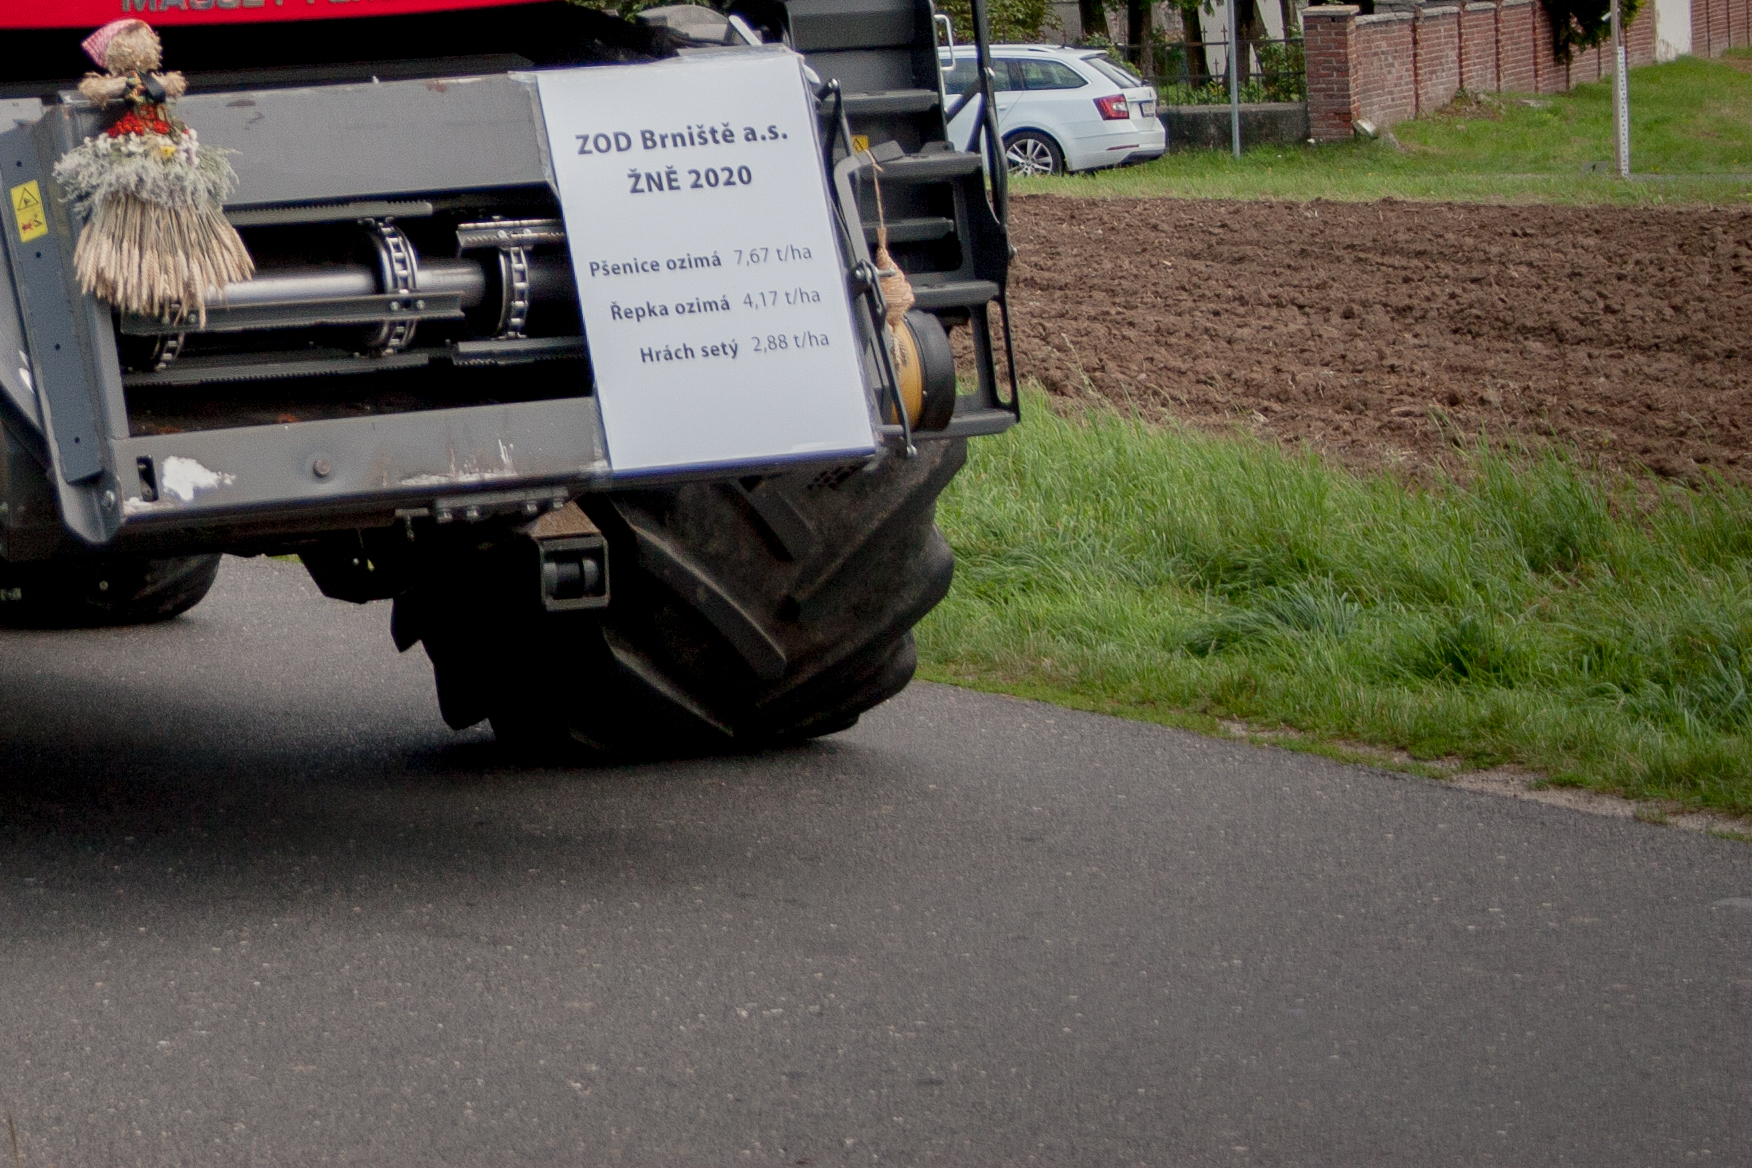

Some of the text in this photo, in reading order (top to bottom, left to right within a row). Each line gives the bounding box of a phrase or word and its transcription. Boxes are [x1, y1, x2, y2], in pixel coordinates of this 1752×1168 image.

[575, 122, 788, 155] ZOD Brniště a.s.
[627, 165, 752, 194] ŽNĚ 2020
[589, 244, 812, 277] Pšenice ozimá 7,67 t/ha
[610, 287, 821, 323] Řepka ozimá 4,17 t/ha
[639, 330, 830, 363] Hrách setý 2,88 t/ha
